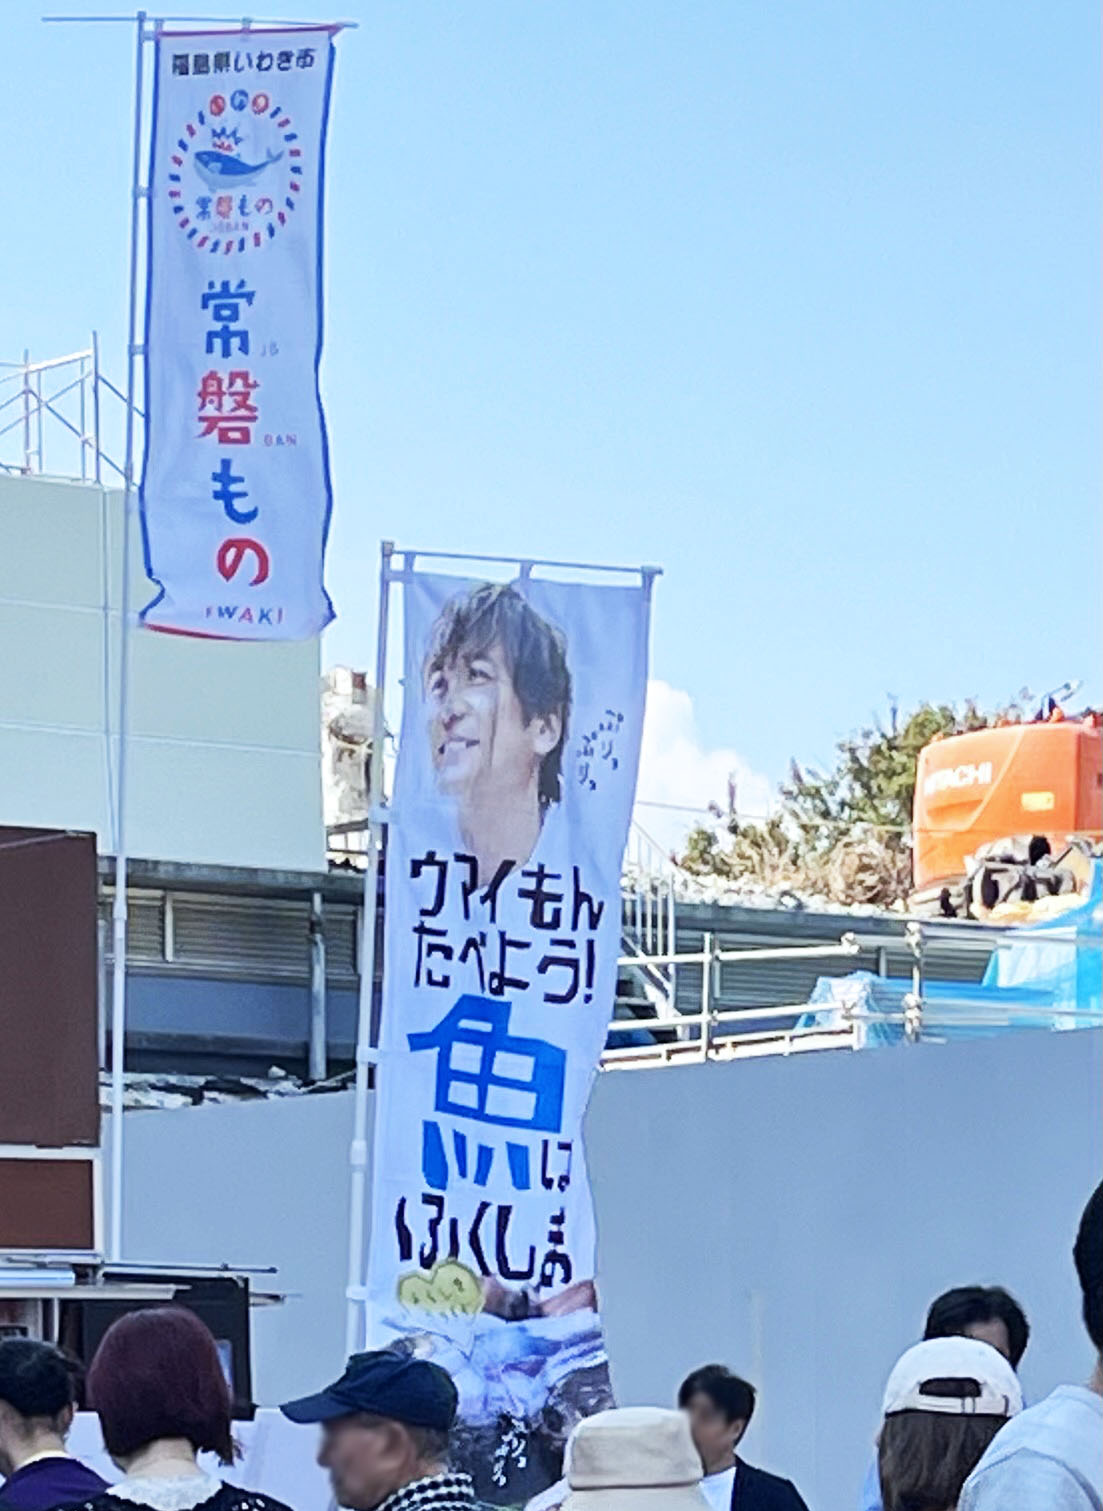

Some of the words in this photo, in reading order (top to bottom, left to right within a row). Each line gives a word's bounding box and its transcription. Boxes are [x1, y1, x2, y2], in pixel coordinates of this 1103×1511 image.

[172, 48, 316, 76] 福島県いわき市
[196, 280, 270, 587] 常磐もの
[205, 606, 284, 626] IWAKI
[412, 919, 597, 1005] たべよう!
[394, 1192, 575, 1288] ふくしま
